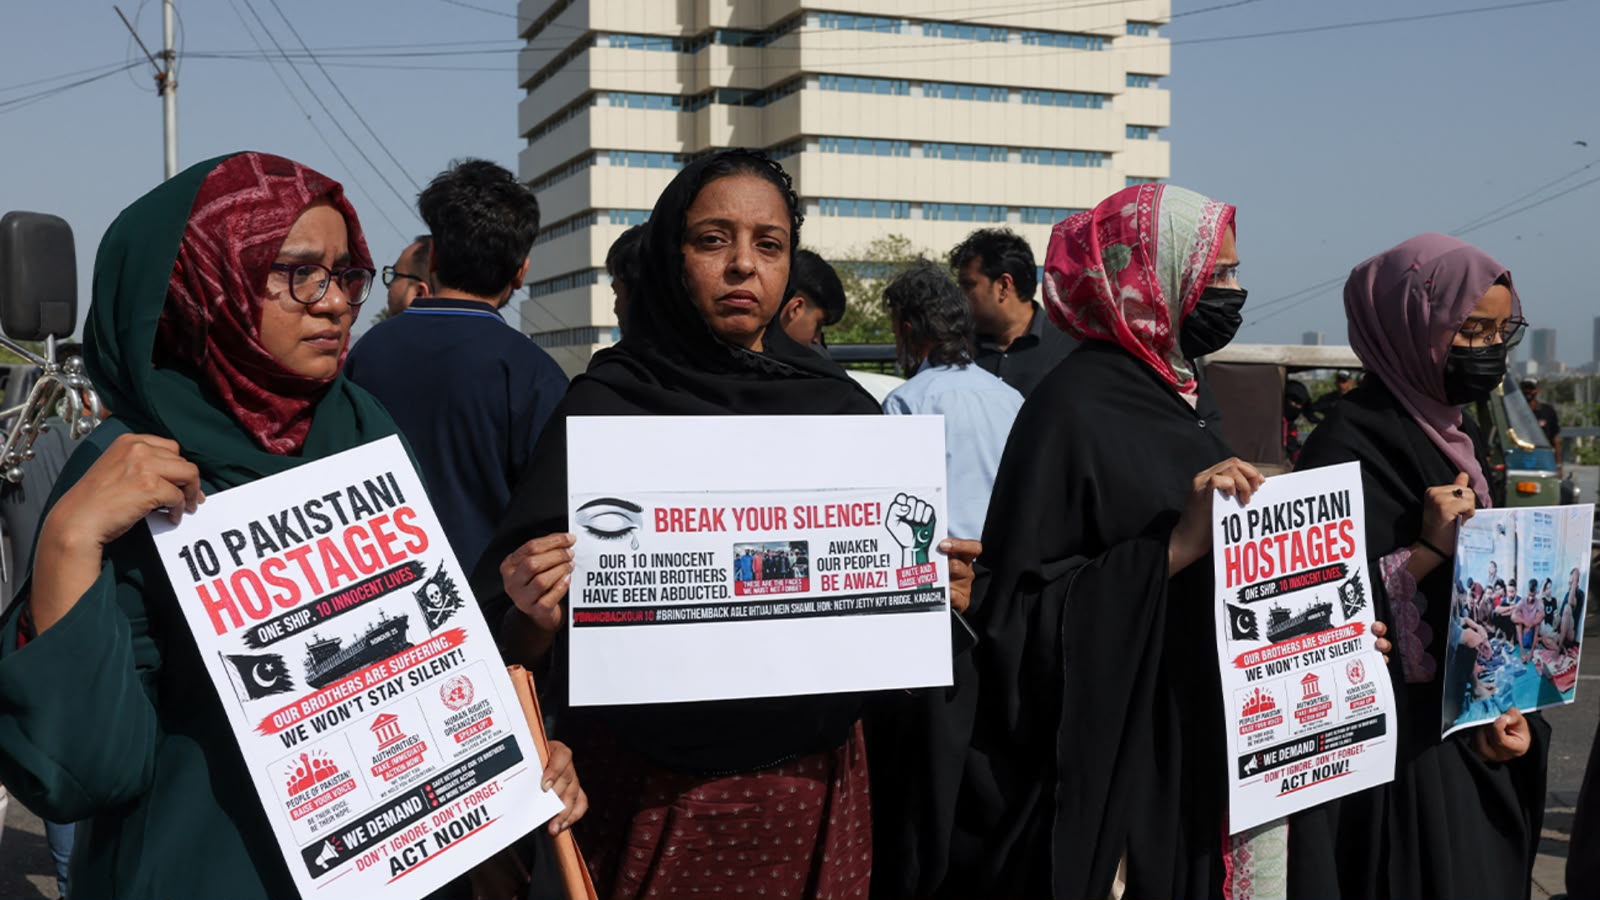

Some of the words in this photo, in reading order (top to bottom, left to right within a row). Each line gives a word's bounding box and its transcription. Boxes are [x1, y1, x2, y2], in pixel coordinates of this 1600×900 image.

[178, 539, 220, 582] 10
[220, 471, 405, 566] PAKISTANI
[654, 506, 726, 533] BREAK
[731, 505, 787, 531] YOUR
[793, 502, 881, 529] SILENCE!
[1221, 513, 1241, 545] 10
[1246, 489, 1350, 539] PAKISTANI
[599, 554, 625, 569] OUR
[631, 553, 647, 568] 10
[651, 551, 714, 567] INNOCENT
[817, 557, 840, 571] OUR
[843, 553, 890, 569] PEOPLE!
[828, 539, 877, 554] AWAKEN
[1224, 519, 1355, 588] HOSTAGES
[195, 506, 428, 635] HOSTAGES
[586, 570, 655, 586] PAKISTANI
[660, 568, 726, 584] BROTHERS
[821, 574, 839, 591] BE
[843, 570, 887, 589] AWAZ!
[1244, 586, 1259, 600] ONE
[1259, 582, 1277, 596] SHIP.
[1279, 579, 1286, 590] 10
[1288, 570, 1320, 588] INNOCENT
[1323, 566, 1342, 580] LIVES.
[257, 621, 284, 642] ONE
[282, 609, 316, 631] SHIP.
[315, 601, 330, 616] 10
[330, 578, 383, 611] INNOCENT
[383, 566, 416, 588] LIVES.
[582, 588, 618, 603] HAVE
[622, 586, 656, 602] BEEN
[660, 584, 731, 600] ABDUCTED.
[656, 606, 729, 621] #BRINGTHEMBACK
[834, 599, 855, 611] NETTY
[855, 597, 874, 609] JETTY
[1243, 651, 1259, 665] OUR
[1261, 640, 1300, 660] BROTHERS
[1301, 636, 1316, 649] ARE
[1317, 625, 1356, 644] SUFFERING.
[1245, 666, 1262, 681] WE
[1265, 655, 1299, 676] WON'T
[1303, 648, 1325, 666] STAY
[1328, 637, 1361, 658] SILENT!
[273, 706, 300, 727] OUR
[300, 676, 363, 715] BROTHERS
[365, 664, 388, 685] ARE
[388, 636, 452, 672] SUFFERING.
[279, 723, 308, 748] WE
[309, 695, 363, 733] WON'T
[367, 676, 404, 705] STAY
[407, 648, 465, 686] SILENT!
[443, 710, 467, 725] HUMAN
[467, 698, 489, 714] RIGHTS
[372, 734, 418, 764] AUTHORITIES!
[1263, 751, 1276, 765] WE
[1278, 739, 1314, 760] DEMAND
[1264, 767, 1285, 783] DON'T
[1287, 759, 1313, 775] IGNORE.
[1315, 751, 1335, 766] DON'T
[1337, 743, 1364, 758] FORGET.
[285, 791, 310, 809] PEOPLE
[310, 786, 318, 796] OF
[319, 770, 349, 790] PAKISTAN!
[1280, 772, 1306, 792] ACT
[1312, 759, 1349, 782] NOW!
[342, 826, 367, 849] WE
[365, 796, 422, 837] DEMAND
[355, 844, 388, 871] DON'T
[389, 821, 432, 851] IGNORE.
[431, 801, 462, 827] DON'T
[463, 780, 503, 809] FORGET.
[389, 838, 428, 876] ACT
[432, 804, 490, 848] NOW!
